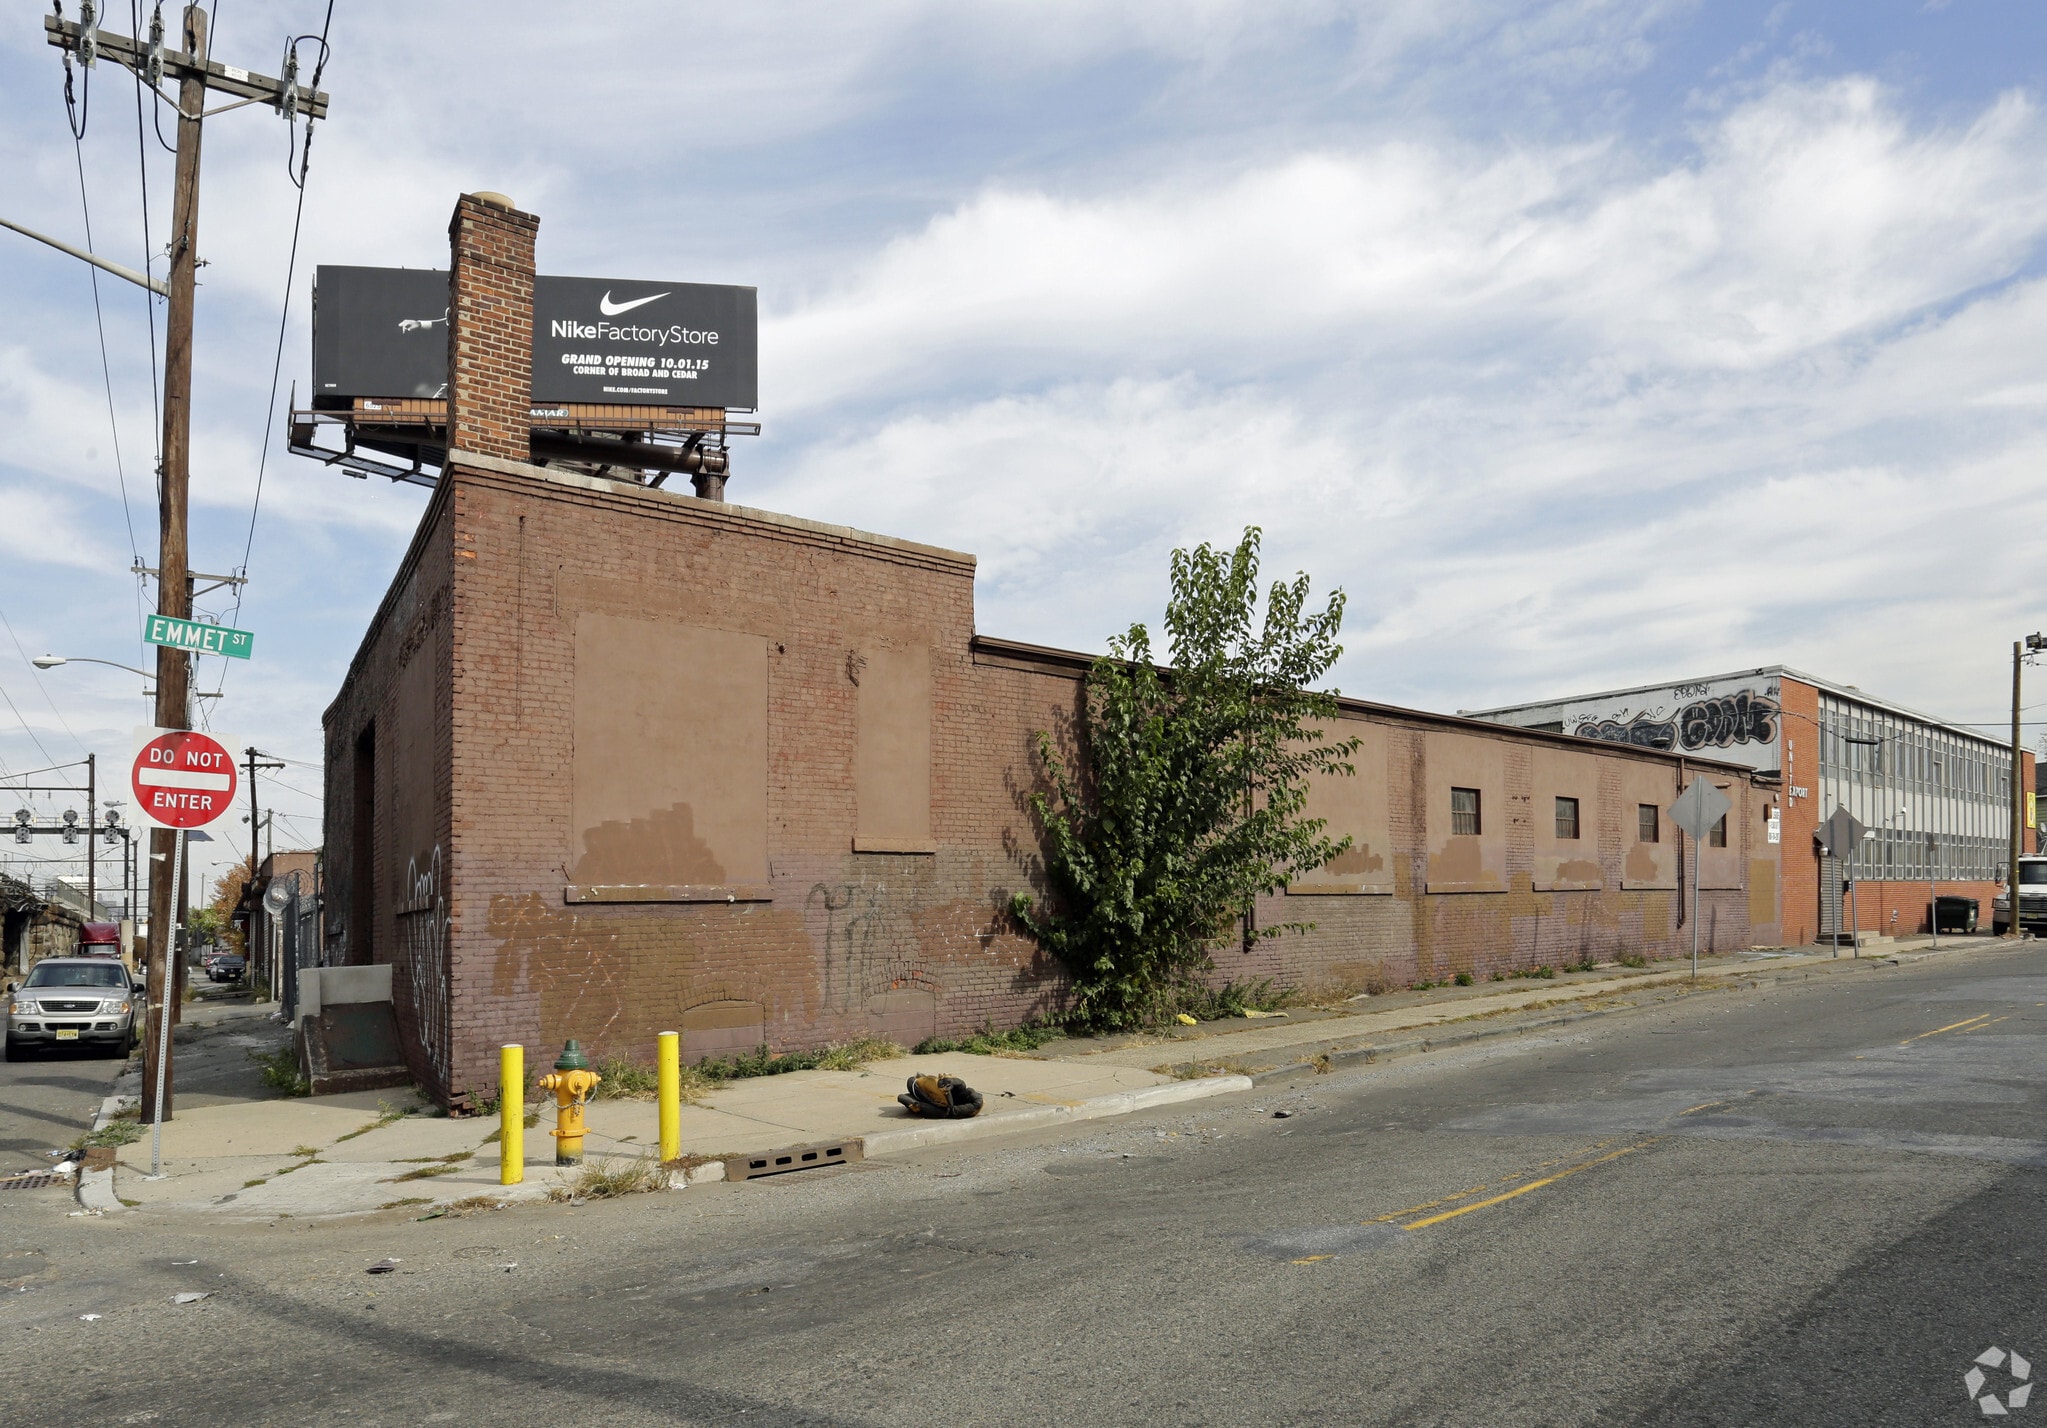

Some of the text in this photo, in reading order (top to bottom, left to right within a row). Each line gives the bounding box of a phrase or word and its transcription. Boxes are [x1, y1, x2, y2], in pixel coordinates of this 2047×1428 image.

[561, 353, 710, 370] GRAND OPENING 10.01.15
[573, 365, 698, 379] CORNER OF BROAD AND CEDAR
[530, 408, 565, 417] AMAR
[151, 619, 247, 651] EMMET ST
[149, 747, 223, 768] DO NOT
[1788, 785, 1808, 798] EXPORT
[153, 791, 213, 810] ENTER
